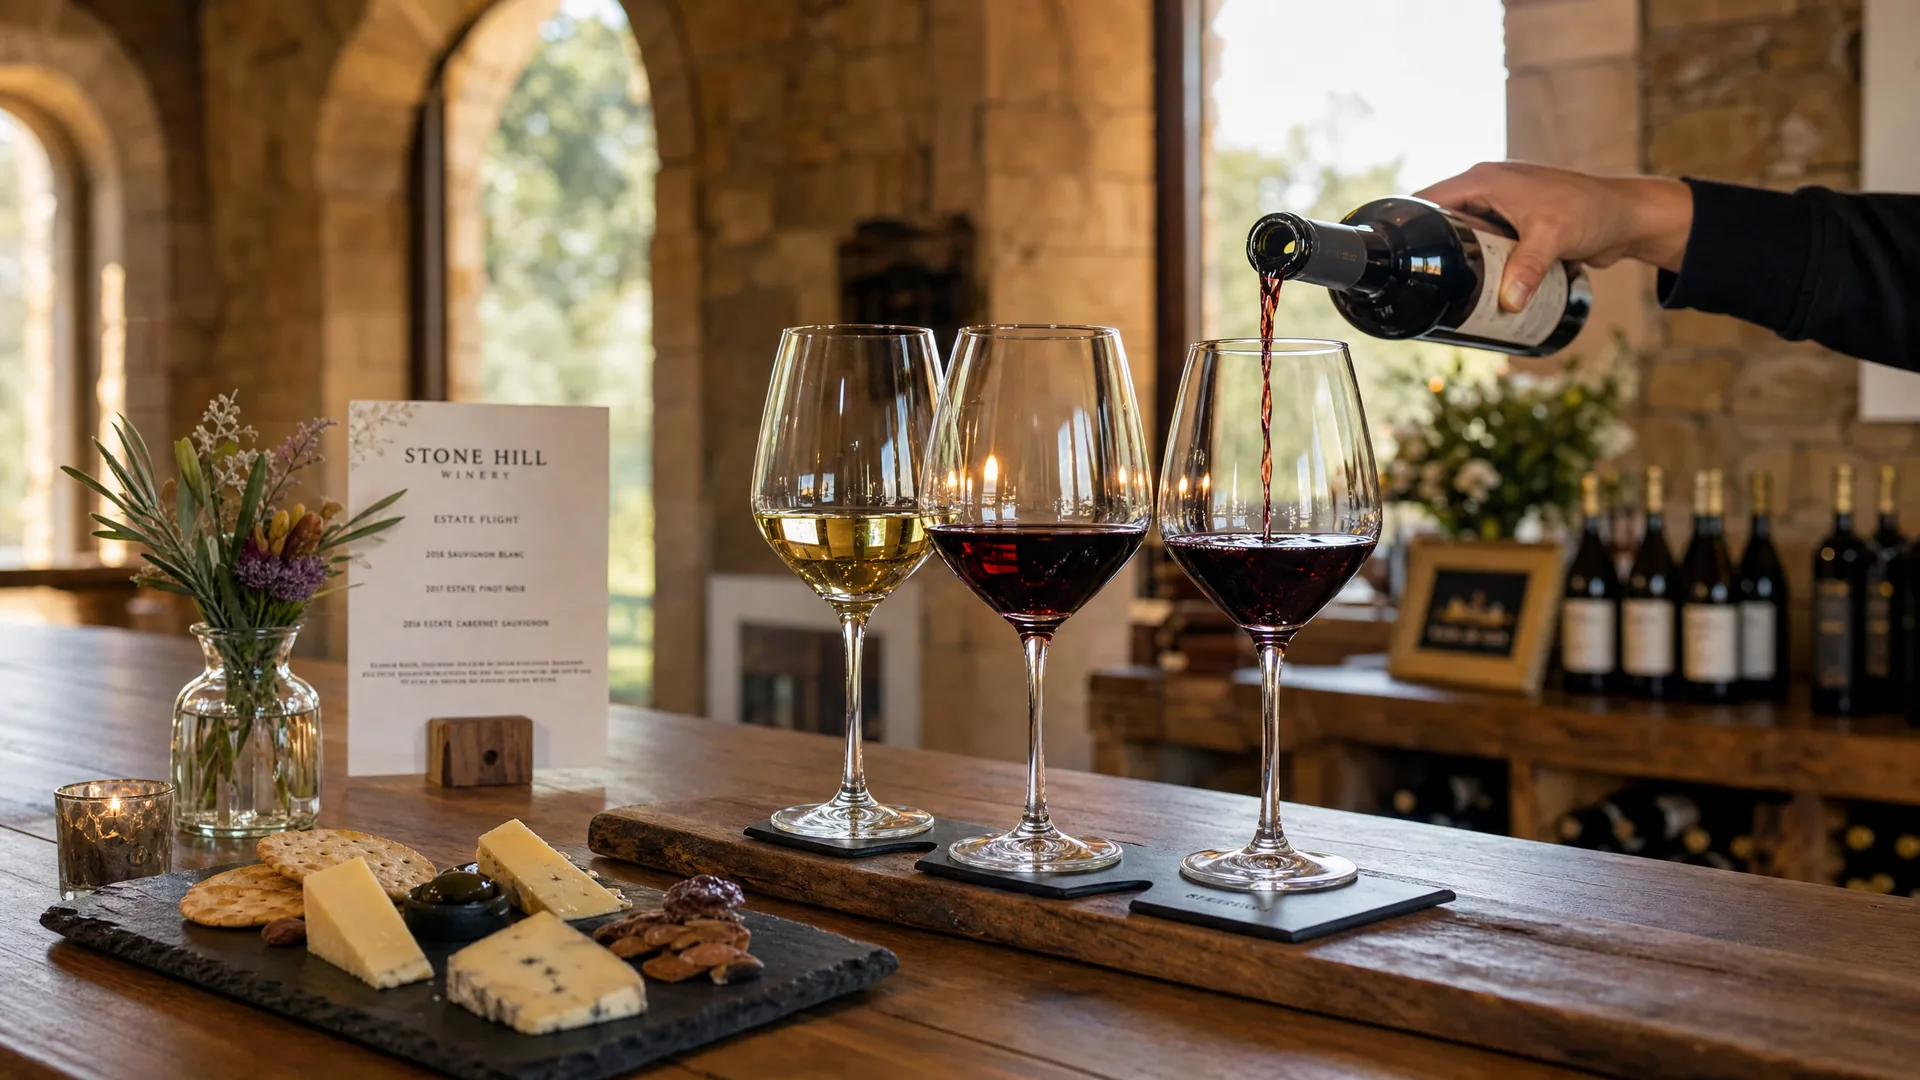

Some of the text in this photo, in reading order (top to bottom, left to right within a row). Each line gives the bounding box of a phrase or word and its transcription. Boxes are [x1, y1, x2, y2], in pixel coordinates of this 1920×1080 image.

[404, 446, 548, 467] STONE HILL
[440, 469, 511, 480] WINERY
[433, 514, 519, 525] ESTATE FLIGHT
[425, 550, 525, 560] 2018 SAUVIGNON BLANC
[425, 584, 526, 594] 2017 ESTATE PINOT NOIR
[423, 619, 453, 629] ESTATE
[455, 619, 499, 629] CABERNET
[501, 619, 550, 629] SAUVIGNON
